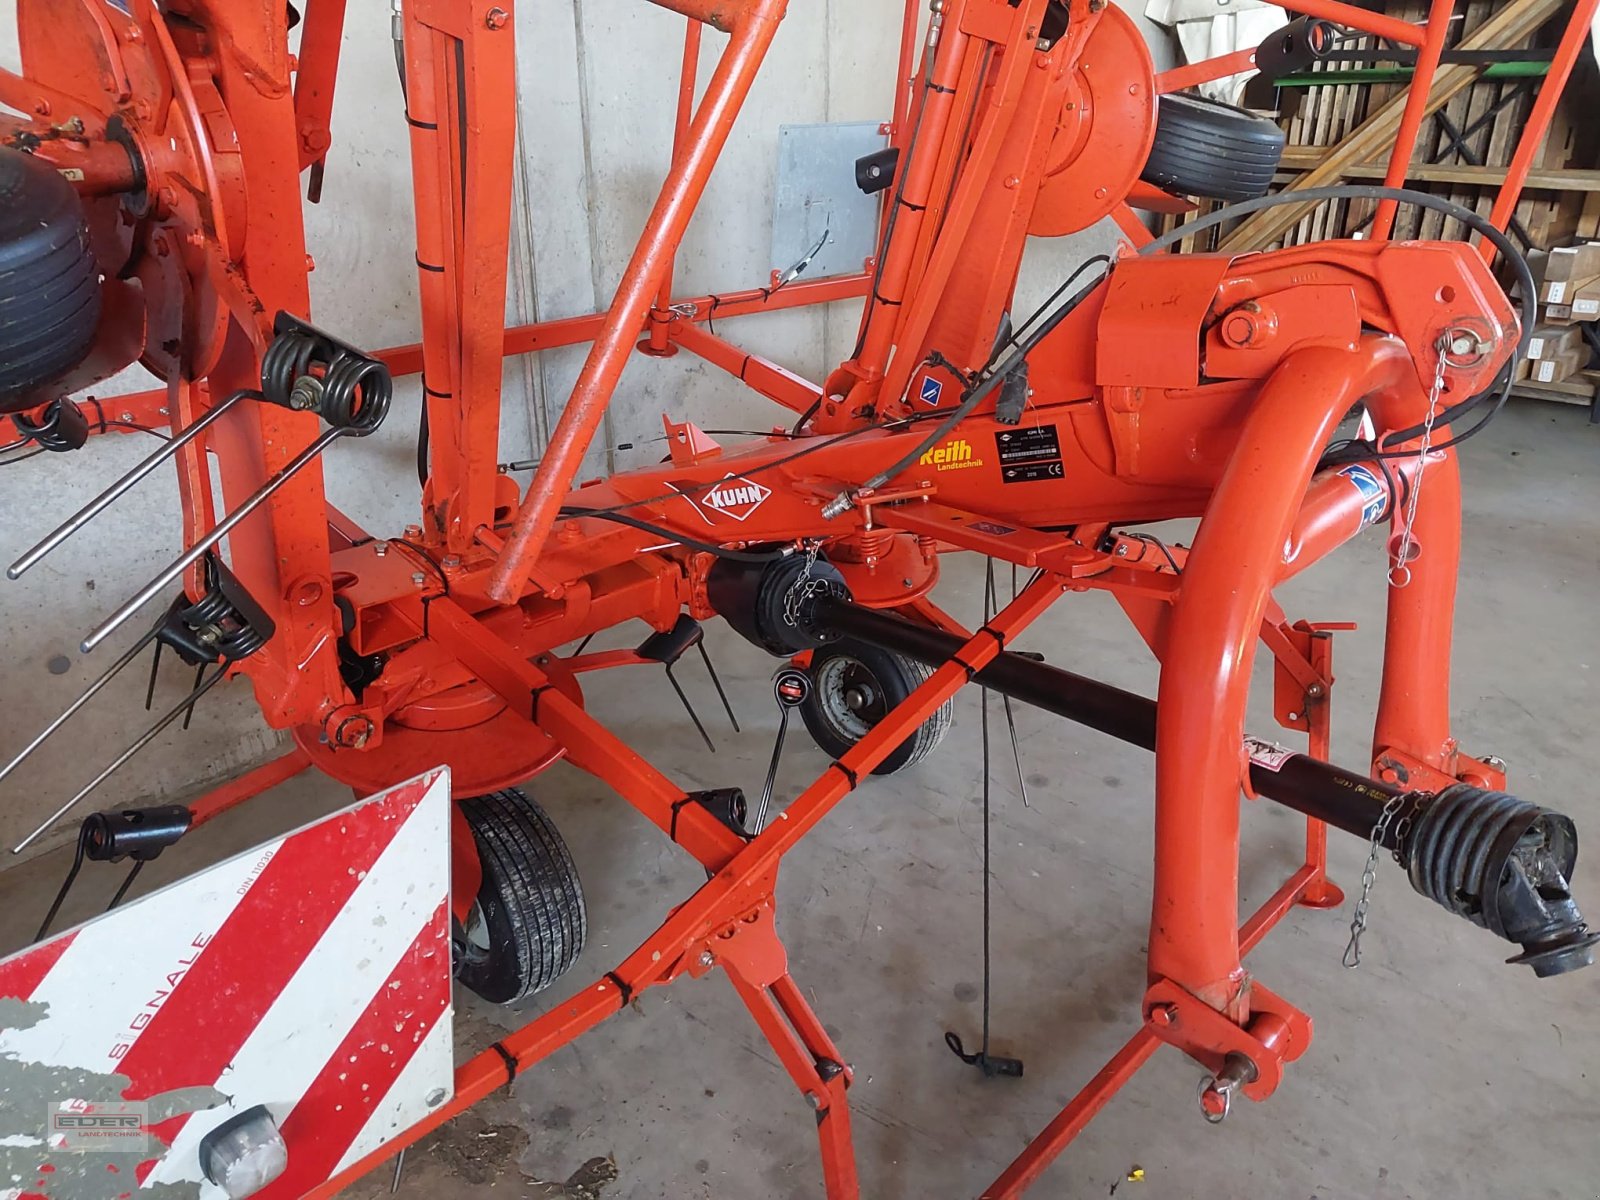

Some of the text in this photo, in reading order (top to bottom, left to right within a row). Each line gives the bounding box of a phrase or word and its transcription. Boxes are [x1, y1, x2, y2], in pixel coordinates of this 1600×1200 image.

[920, 440, 971, 465] Keith
[937, 459, 983, 471] Landtechnik
[711, 485, 762, 508] KUHN
[236, 851, 273, 895] DIN 11030
